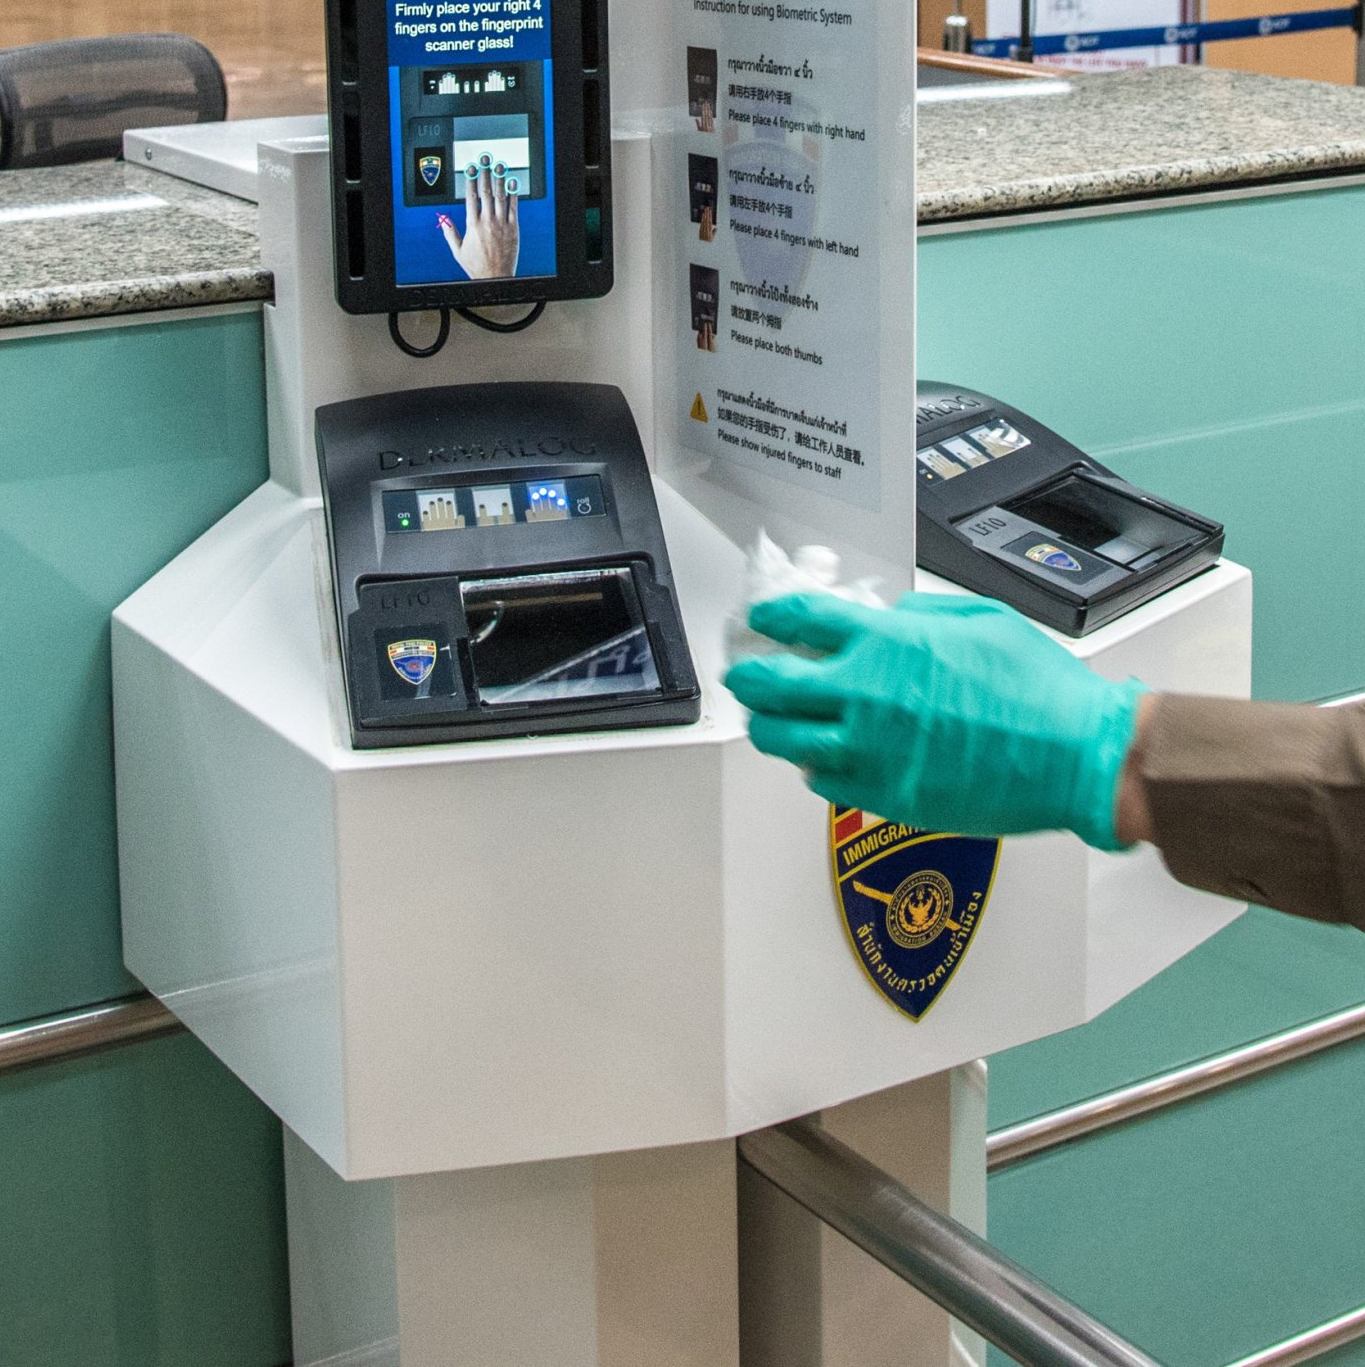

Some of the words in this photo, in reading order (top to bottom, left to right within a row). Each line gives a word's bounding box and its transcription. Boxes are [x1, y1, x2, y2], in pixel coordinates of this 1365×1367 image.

[395, 2, 433, 18] Firmly
[436, 1, 470, 17] place
[473, 1, 500, 16] your
[738, 1, 750, 15] for
[752, 3, 775, 21] using
[777, 4, 818, 22] Biometric
[820, 8, 852, 27] System
[395, 22, 437, 37] fingers
[440, 22, 456, 32] on
[459, 19, 479, 32] the
[481, 16, 543, 33] fingerprint
[425, 39, 475, 52] scanner
[477, 35, 514, 52] glass!
[728, 108, 751, 123] Please
[752, 114, 771, 128] place
[773, 116, 778, 128] 4
[779, 116, 805, 133] fingers
[806, 121, 823, 134] with
[825, 123, 844, 140] right
[845, 126, 865, 141] hand
[730, 219, 752, 234] Please
[753, 224, 772, 239] place
[774, 228, 779, 240] 4
[780, 229, 806, 247] fingers
[807, 236, 824, 250] with
[826, 240, 838, 253] left
[839, 243, 859, 258] hand
[731, 329, 753, 346] Please
[755, 336, 773, 351] place
[775, 341, 792, 357] both
[794, 347, 823, 365] thumbs
[718, 428, 739, 445] Please
[741, 437, 759, 452] show
[760, 442, 786, 461] injured
[788, 452, 813, 470] fingers
[814, 462, 823, 473] to
[824, 466, 842, 480] staff
[577, 496, 590, 505] roll
[397, 511, 410, 519] on
[969, 517, 1007, 537] LF10
